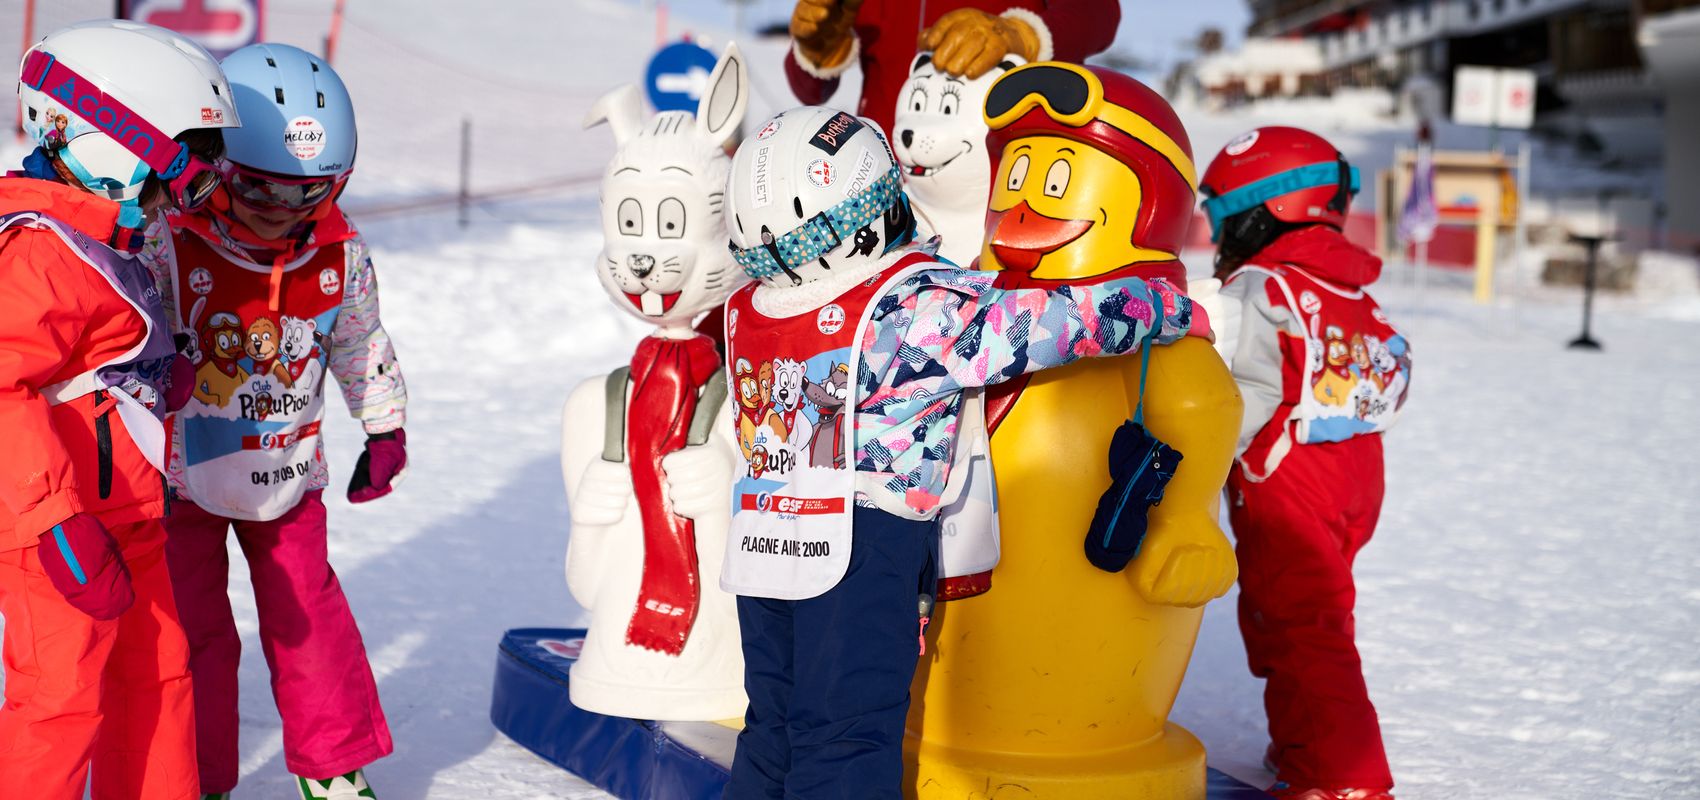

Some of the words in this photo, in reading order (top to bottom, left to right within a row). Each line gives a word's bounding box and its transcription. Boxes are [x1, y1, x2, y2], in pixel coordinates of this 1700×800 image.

[77, 94, 154, 157] cairn
[284, 131, 323, 143] MELODY
[756, 147, 769, 203] BONNET
[251, 380, 272, 392] Club
[251, 471, 269, 486] 04
[280, 466, 295, 481] 09
[778, 498, 804, 513] esf
[741, 536, 779, 554] PLAGNE
[802, 541, 830, 557] 2000
[645, 599, 685, 616] ESF
